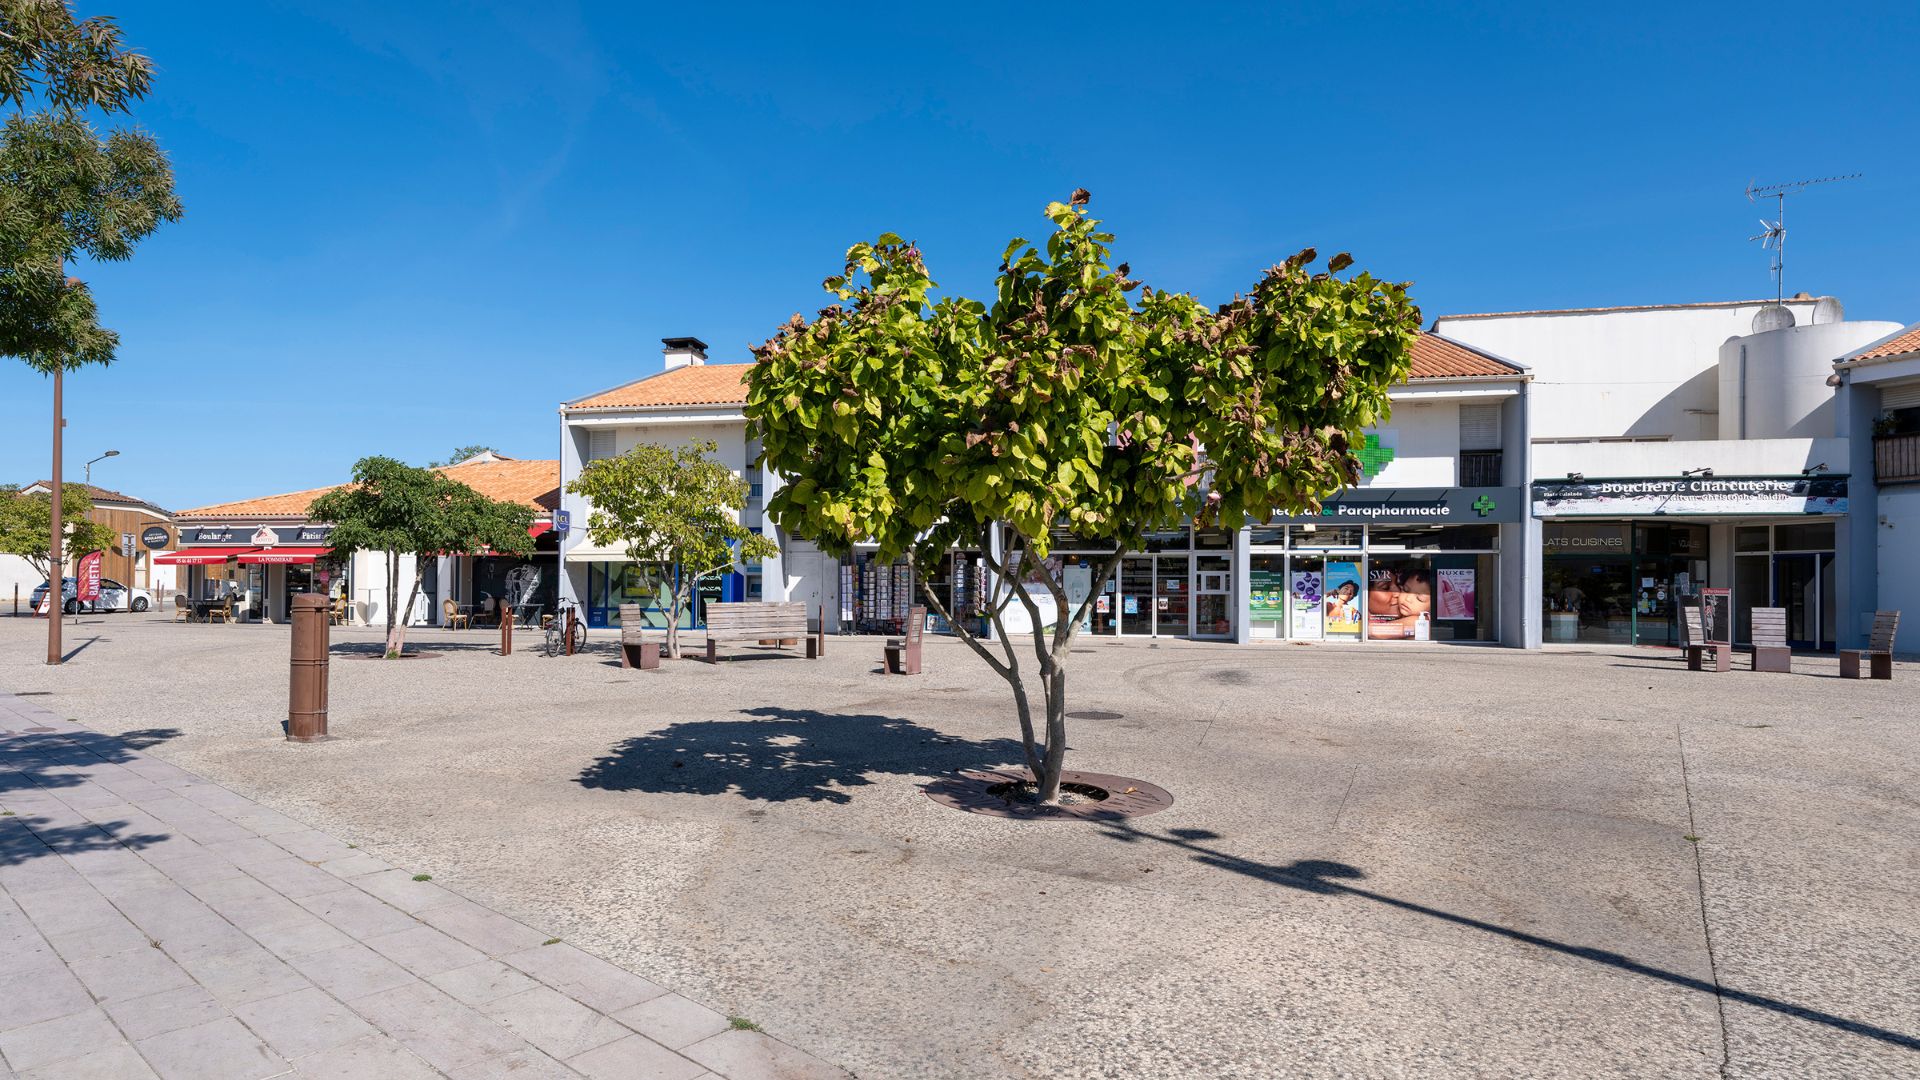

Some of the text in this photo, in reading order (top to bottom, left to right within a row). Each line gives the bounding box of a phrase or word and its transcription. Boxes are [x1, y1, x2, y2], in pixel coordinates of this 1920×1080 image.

[1601, 480, 1788, 493] Boucherie Charcuterie
[1338, 503, 1450, 519] Parapharmacie
[198, 532, 232, 542] Boulanger
[1542, 537, 1623, 546] LATS CUISINES
[88, 557, 100, 596] BANETTE
[1370, 570, 1391, 579] SVR
